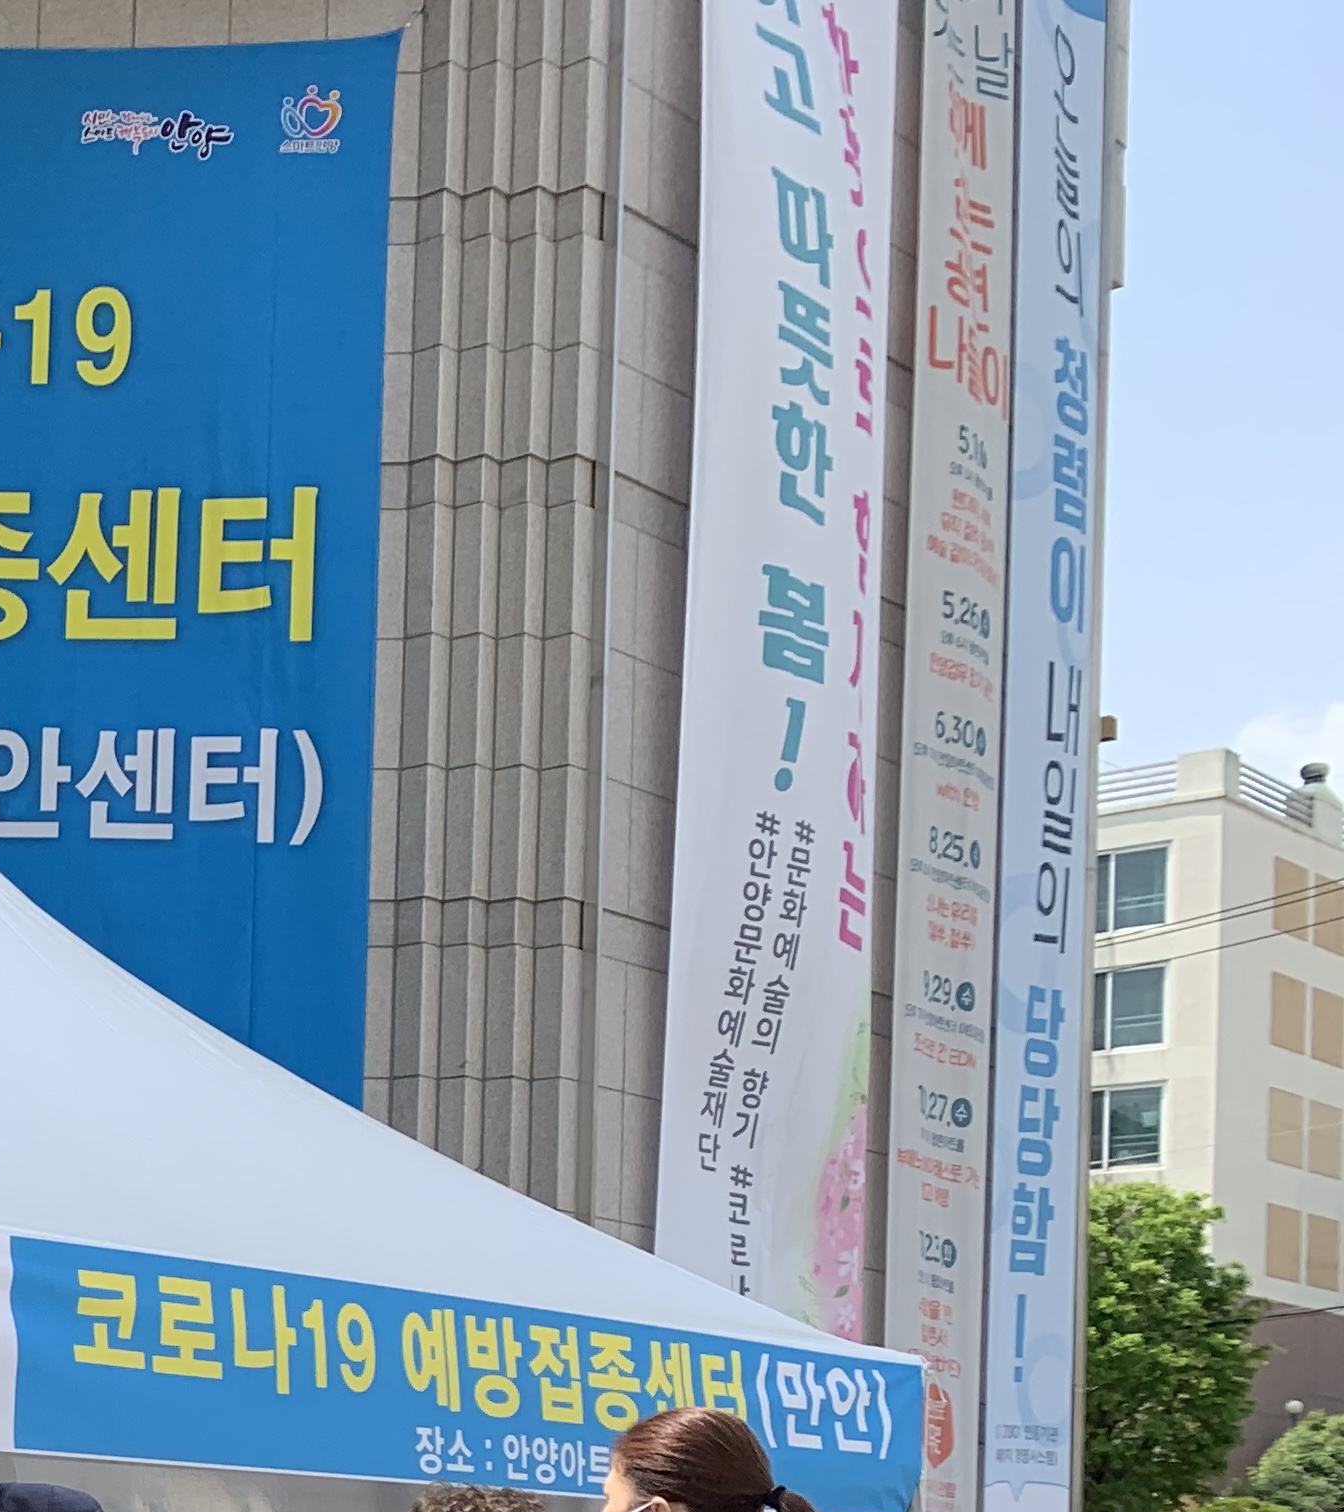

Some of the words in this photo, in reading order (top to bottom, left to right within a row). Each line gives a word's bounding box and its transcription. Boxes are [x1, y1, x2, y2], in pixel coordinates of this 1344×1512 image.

[160, 110, 234, 160] 안양
[1033, 661, 1084, 955] 내일의
[732, 1067, 769, 1149] 향기
[1008, 985, 1066, 1383] 당당함!
[73, 1269, 376, 1394] 코로나19
[415, 1425, 476, 1476] 장소
